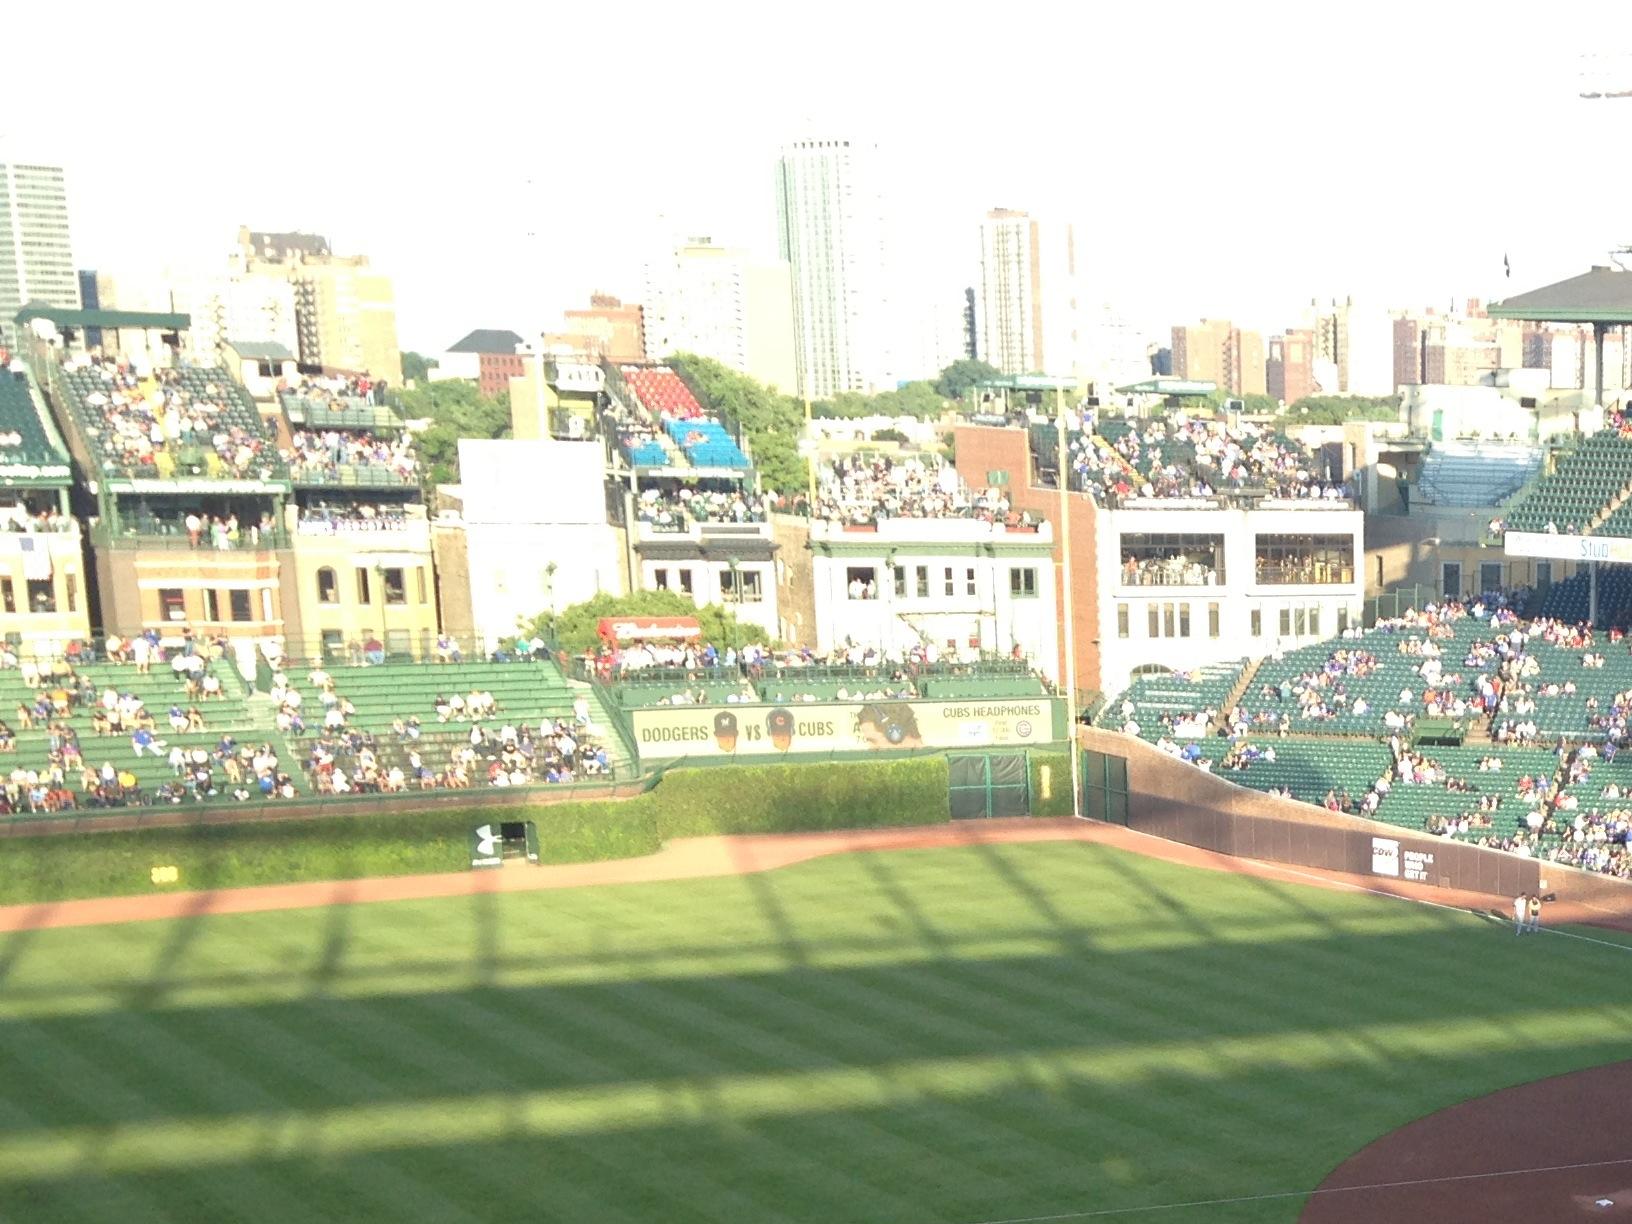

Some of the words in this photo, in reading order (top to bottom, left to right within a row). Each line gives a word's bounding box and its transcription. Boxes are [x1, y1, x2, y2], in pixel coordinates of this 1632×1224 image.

[943, 706, 970, 719] CUBS
[973, 705, 1041, 718] HEADPHONES
[642, 726, 709, 743] DODGERS
[745, 724, 762, 741] VS
[798, 721, 834, 737] CUBS
